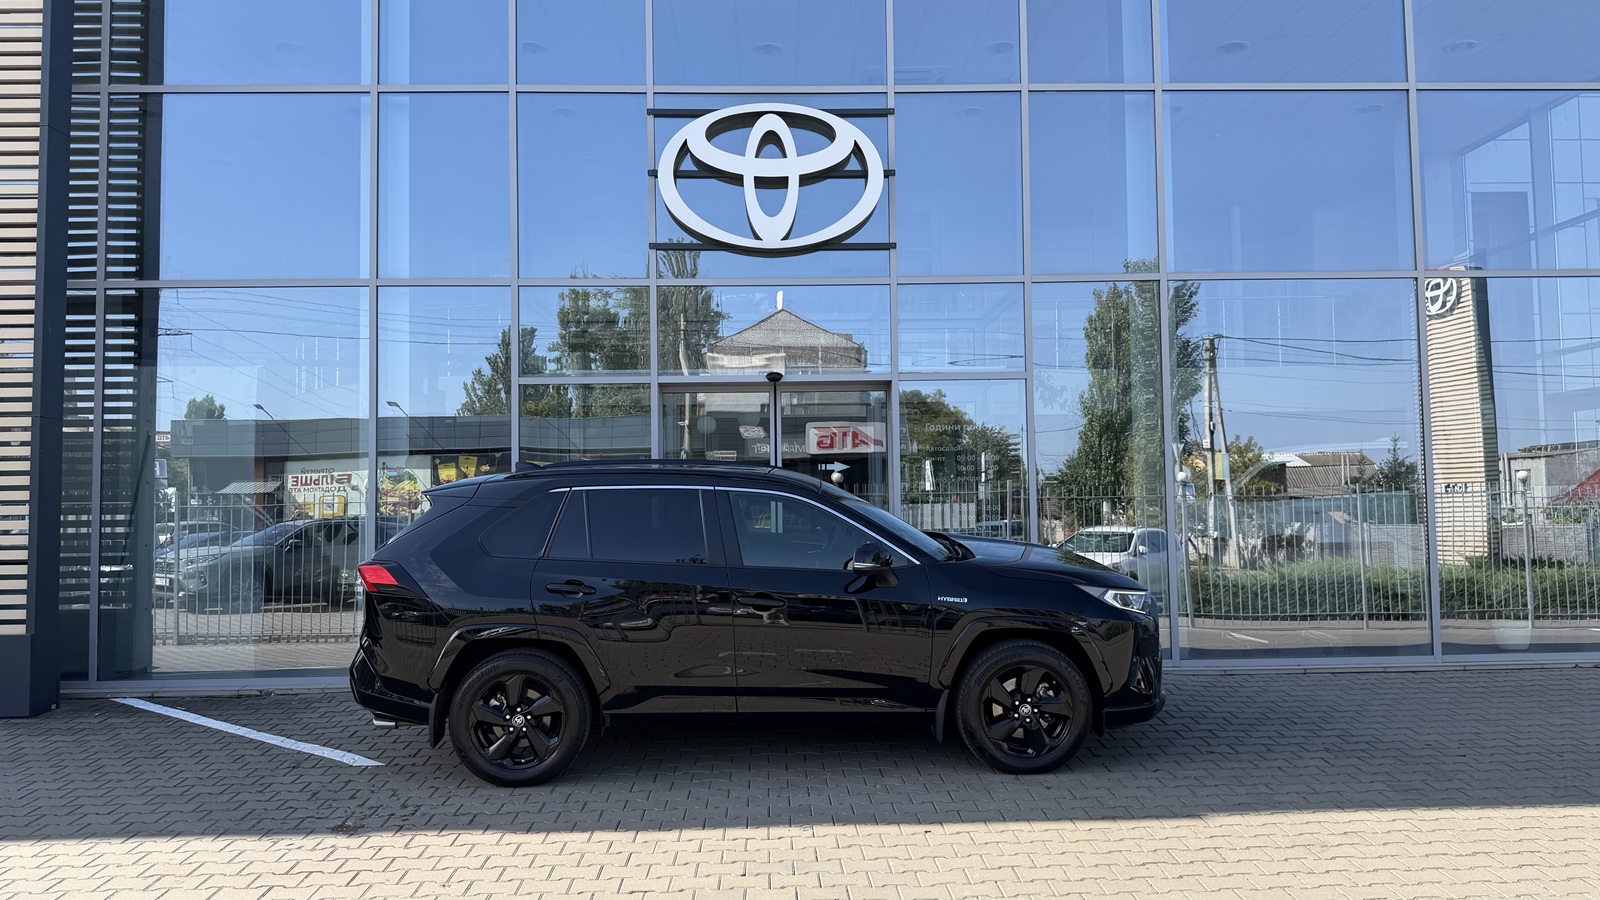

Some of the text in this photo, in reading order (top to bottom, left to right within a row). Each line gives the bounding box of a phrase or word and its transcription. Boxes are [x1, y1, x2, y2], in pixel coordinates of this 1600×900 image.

[926, 424, 960, 433] Години
[974, 651, 1025, 685] BRIDGESTONE
[456, 663, 501, 710] BRIDGESTONE
